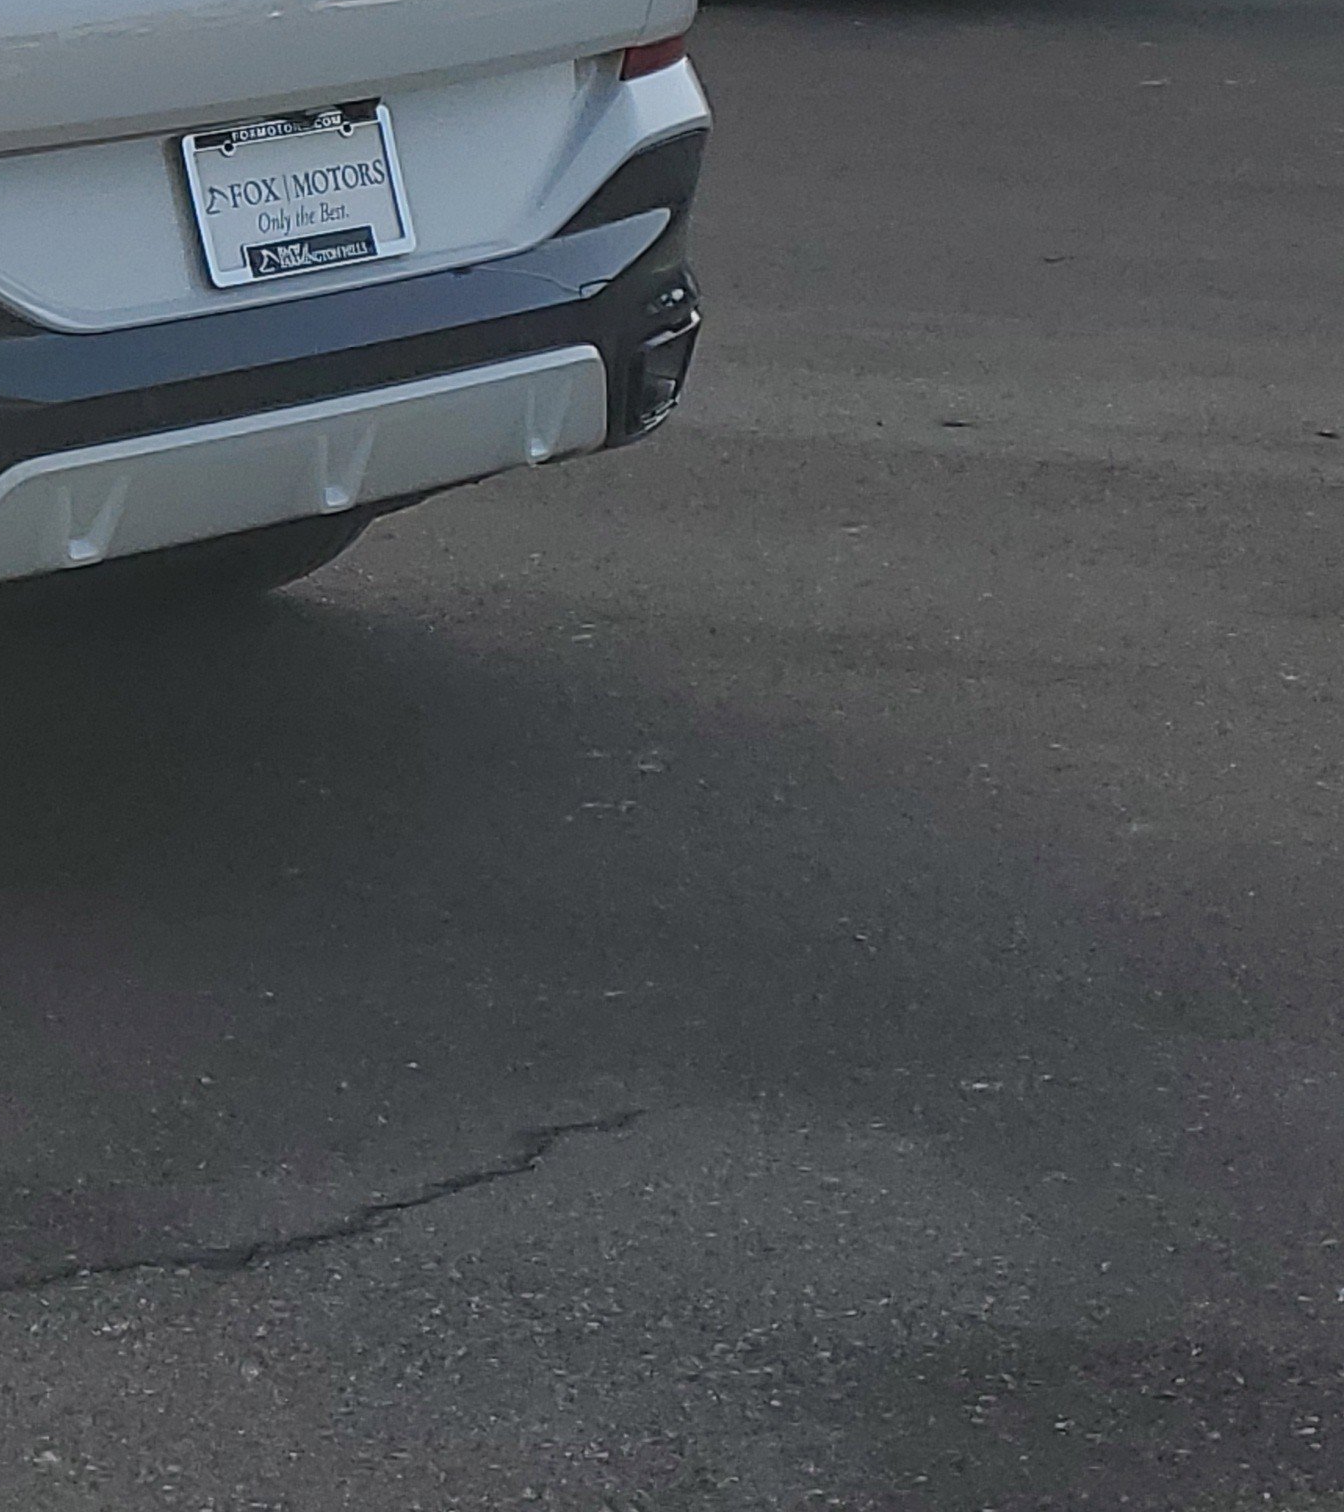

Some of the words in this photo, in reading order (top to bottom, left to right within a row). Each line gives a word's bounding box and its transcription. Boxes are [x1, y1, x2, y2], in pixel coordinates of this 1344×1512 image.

[228, 176, 280, 208] FOX
[292, 159, 385, 198] MOTORS
[258, 207, 292, 236] Only
[296, 204, 316, 228] the
